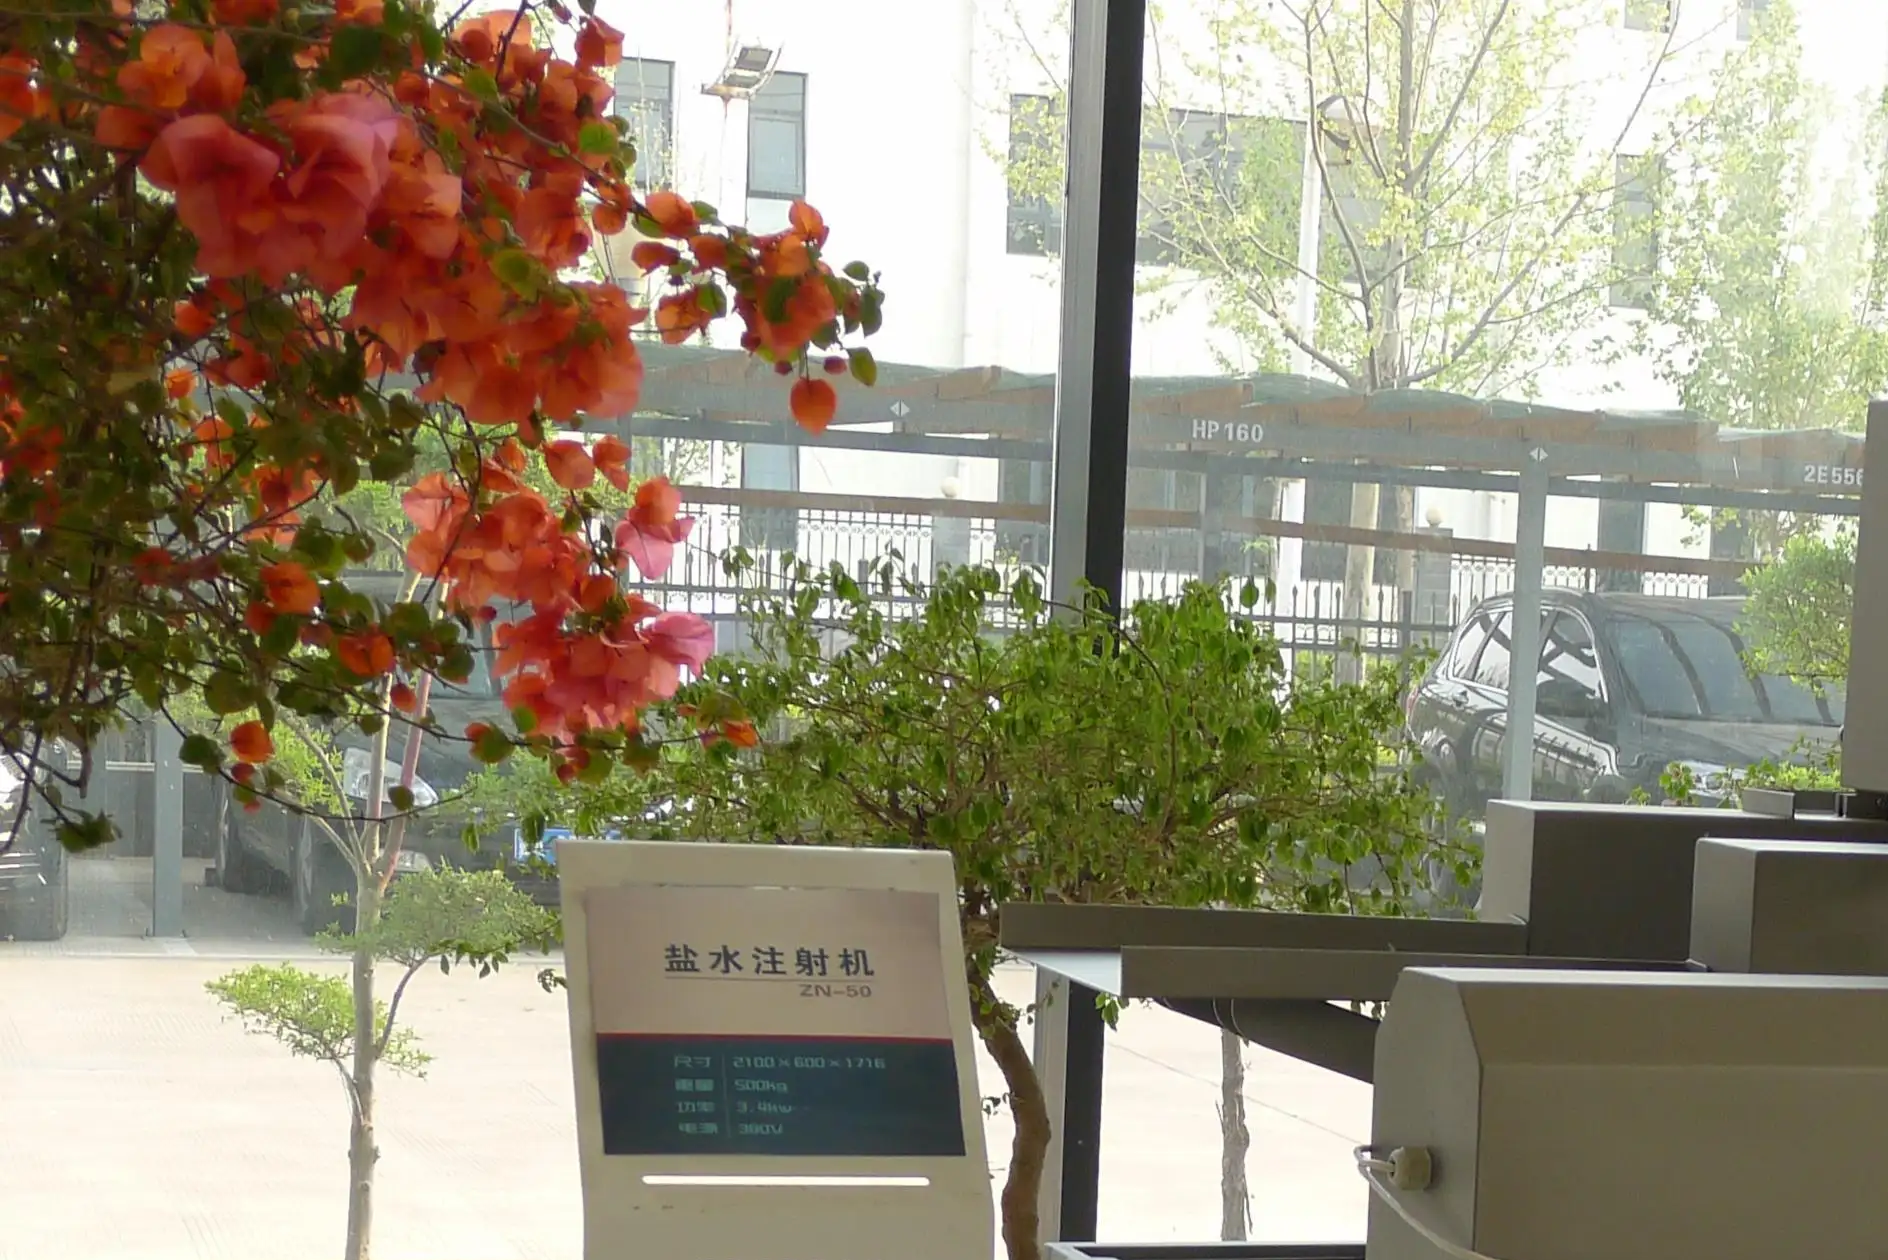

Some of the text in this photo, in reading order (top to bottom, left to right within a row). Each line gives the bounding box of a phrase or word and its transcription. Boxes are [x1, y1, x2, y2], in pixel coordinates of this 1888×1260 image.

[663, 943, 875, 977] 盐水注射机
[798, 983, 873, 998] ZN-50
